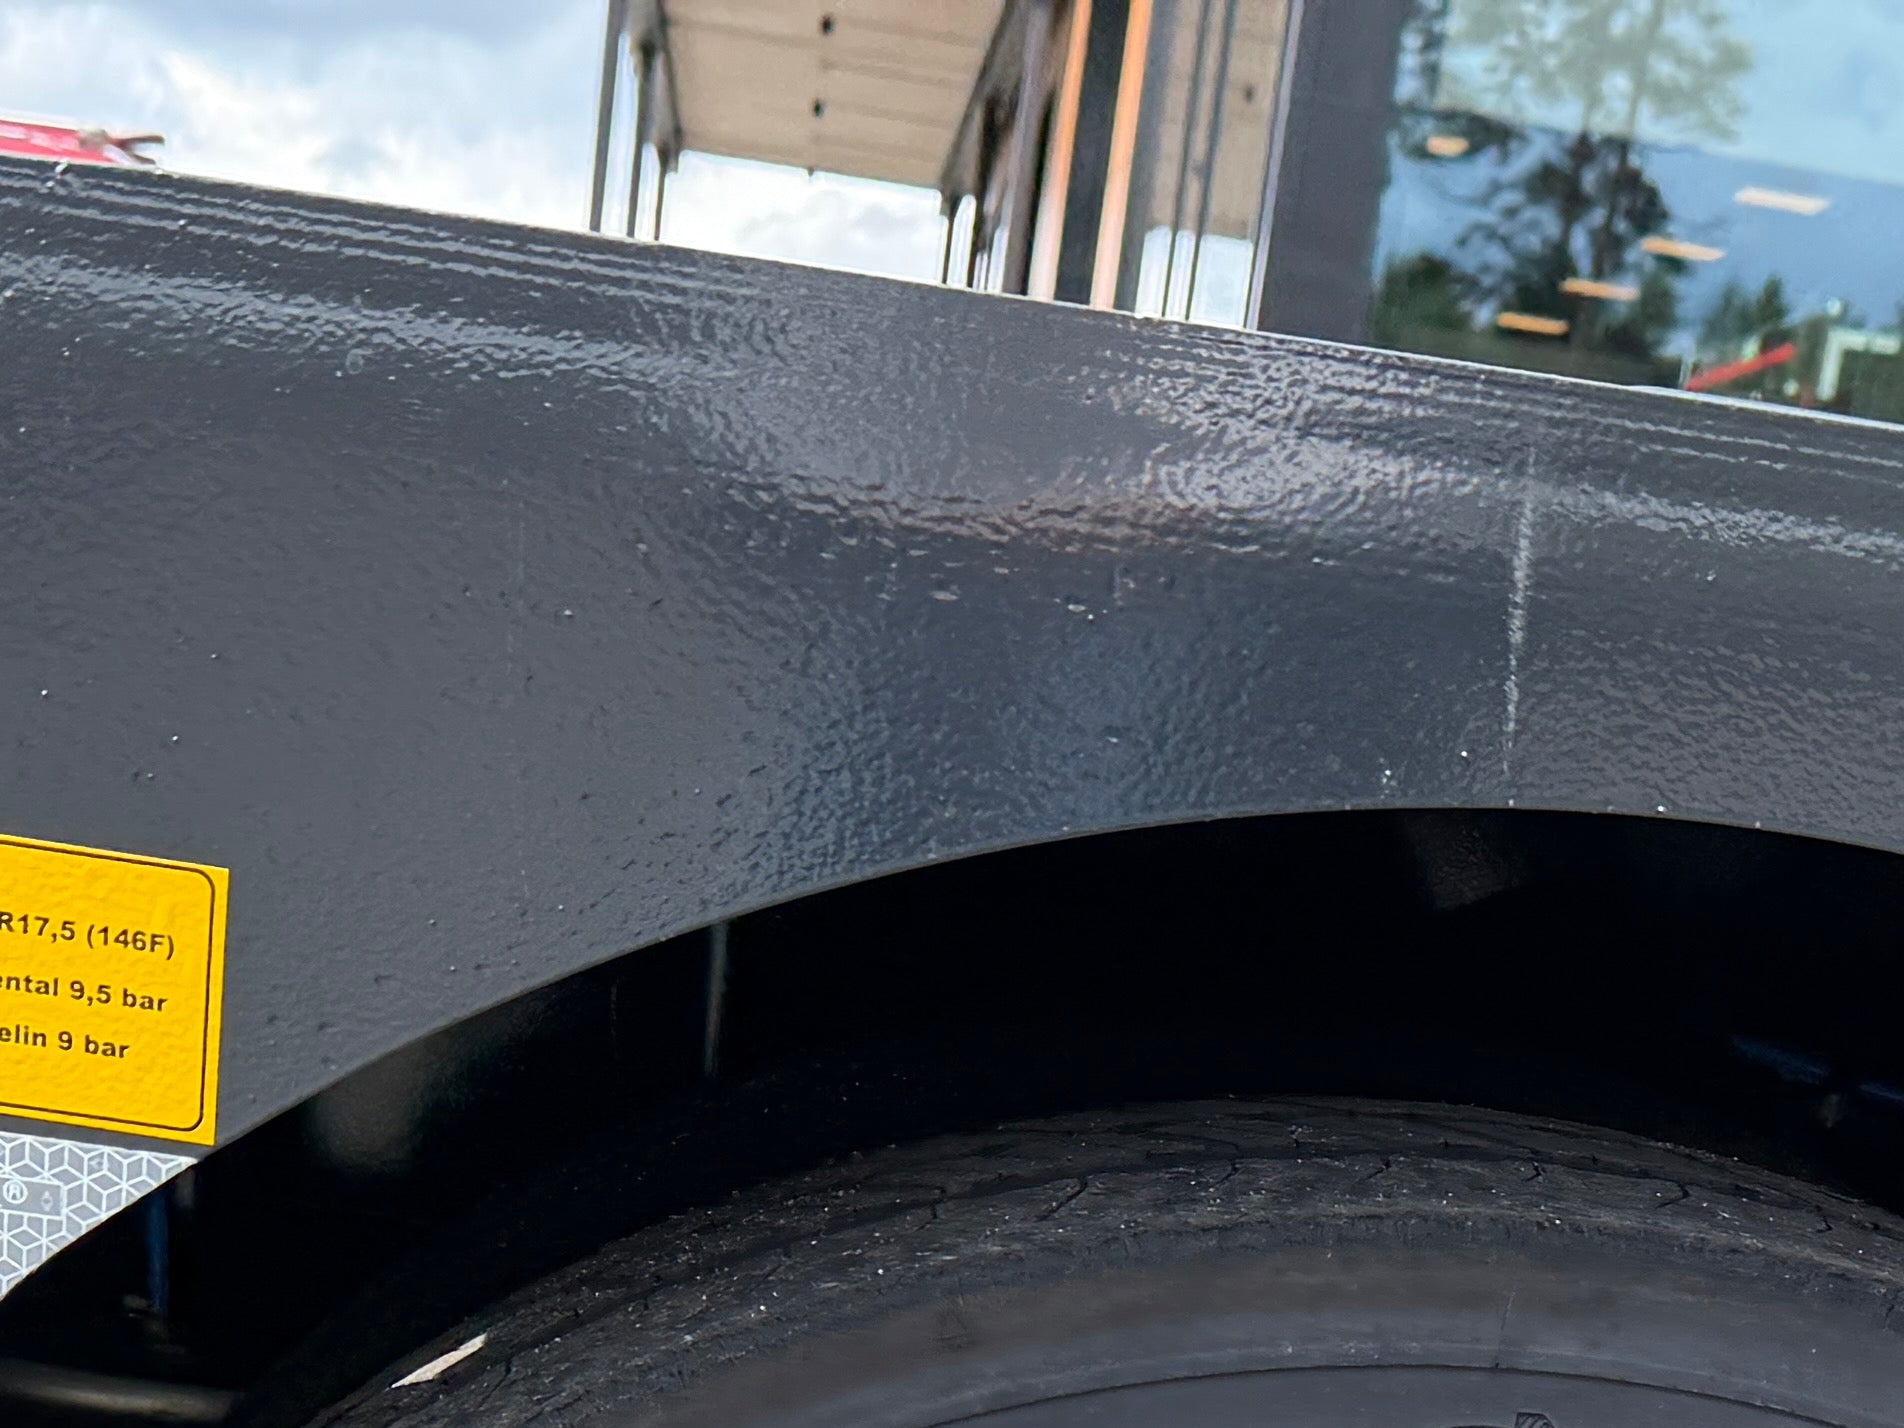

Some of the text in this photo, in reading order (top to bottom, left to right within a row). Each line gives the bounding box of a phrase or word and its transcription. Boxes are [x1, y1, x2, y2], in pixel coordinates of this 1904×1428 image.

[87, 924, 175, 960] (146F)
[70, 980, 111, 1006] 9,5
[121, 985, 168, 1012] bar
[58, 1031, 73, 1051] 9
[84, 1033, 129, 1059] bar
